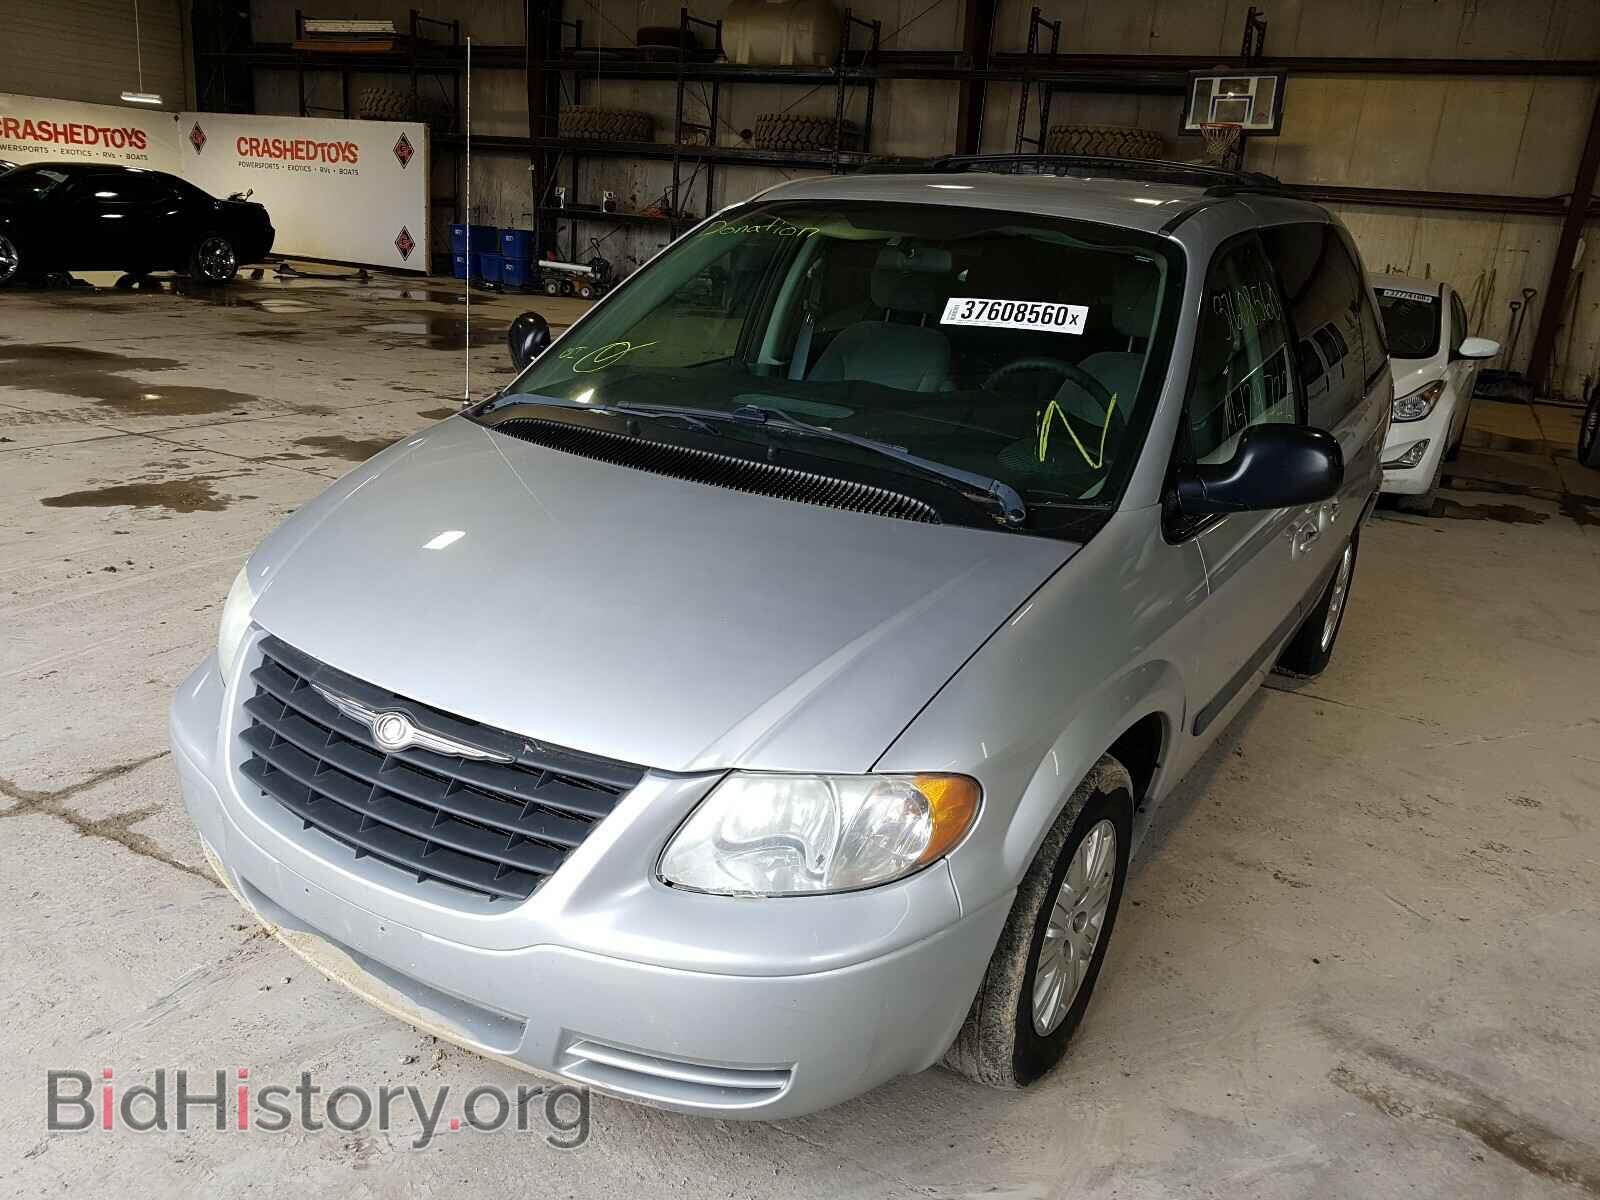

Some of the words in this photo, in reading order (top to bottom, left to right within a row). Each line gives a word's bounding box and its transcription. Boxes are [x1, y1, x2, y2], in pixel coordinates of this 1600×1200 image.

[0, 117, 147, 150] RASHEDTOYS
[60, 148, 92, 157] EXOTICS
[126, 153, 148, 161] BOATS
[236, 136, 359, 164] CRASHEDTOYS
[238, 161, 280, 170] POWERSPORTS
[287, 164, 311, 173] EXOTICS
[339, 168, 359, 176] BOATS
[960, 300, 1069, 326] 37608560
